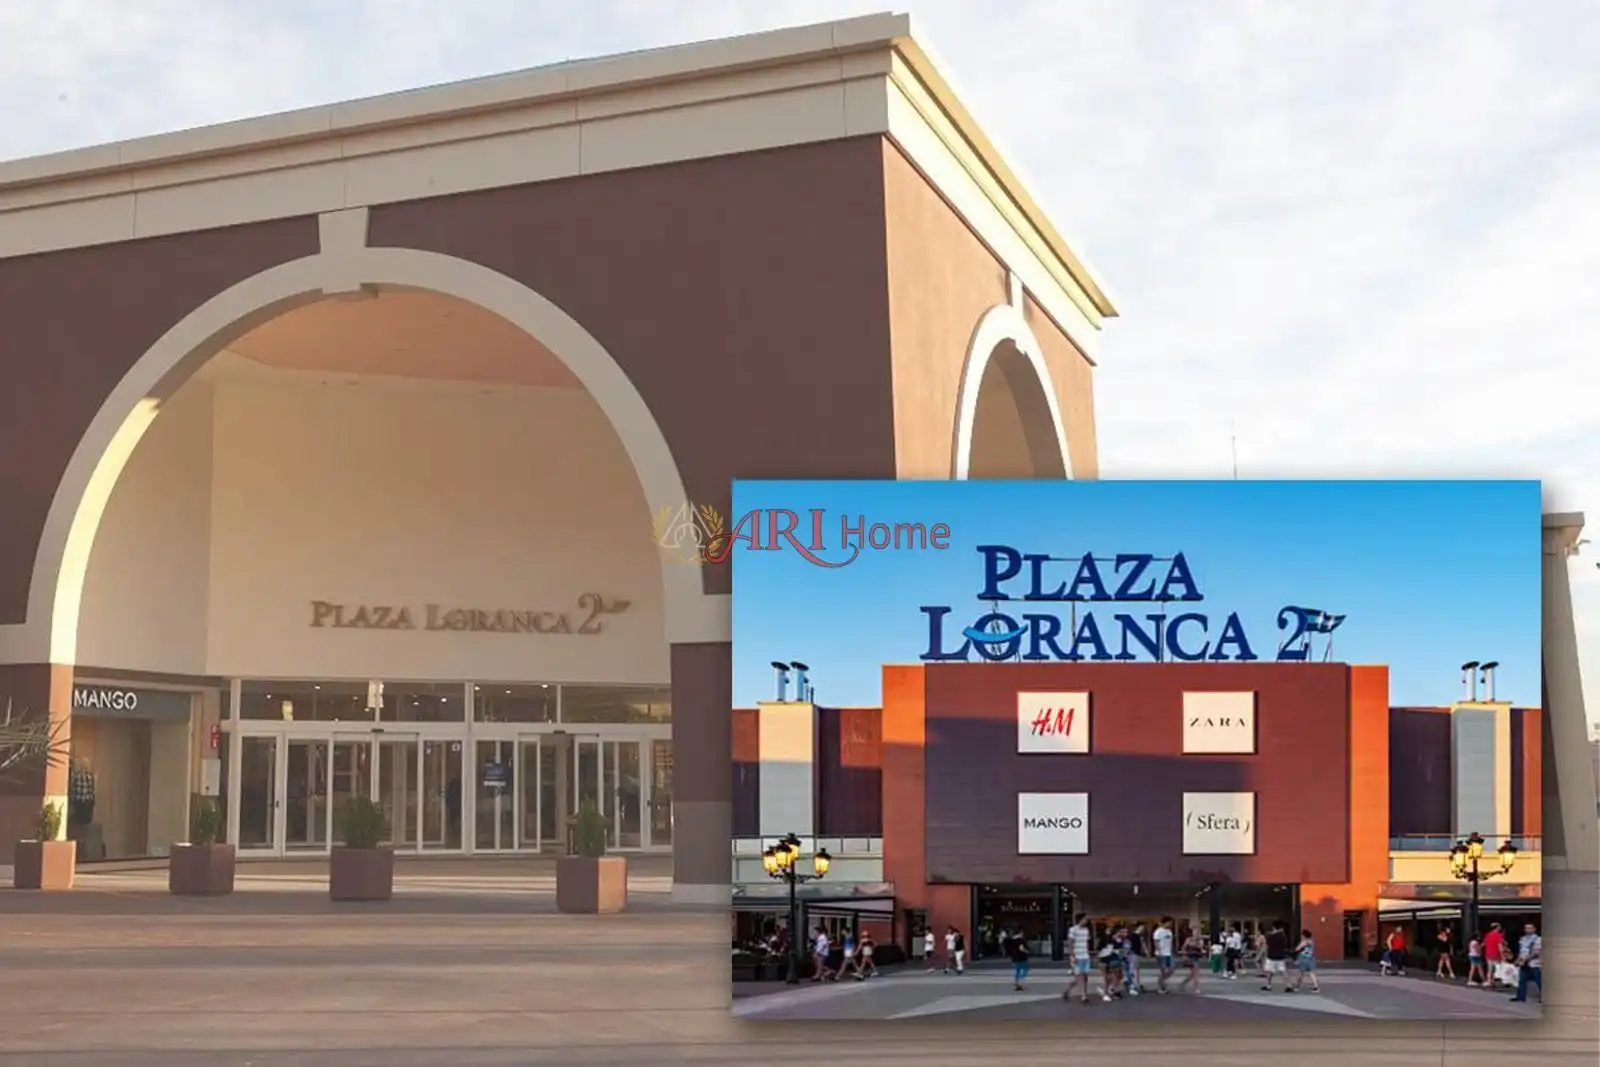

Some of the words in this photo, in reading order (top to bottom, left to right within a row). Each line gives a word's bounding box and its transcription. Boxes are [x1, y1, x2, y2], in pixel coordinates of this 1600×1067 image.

[976, 545, 1204, 601] PLAZA
[309, 600, 417, 630] PLAZA
[424, 603, 575, 634] LORANCA
[577, 592, 606, 635] 2
[919, 606, 1257, 662] LORANCA
[73, 689, 138, 711] MANGO
[1190, 717, 1247, 727] ZARA
[1024, 817, 1082, 830] MANGO
